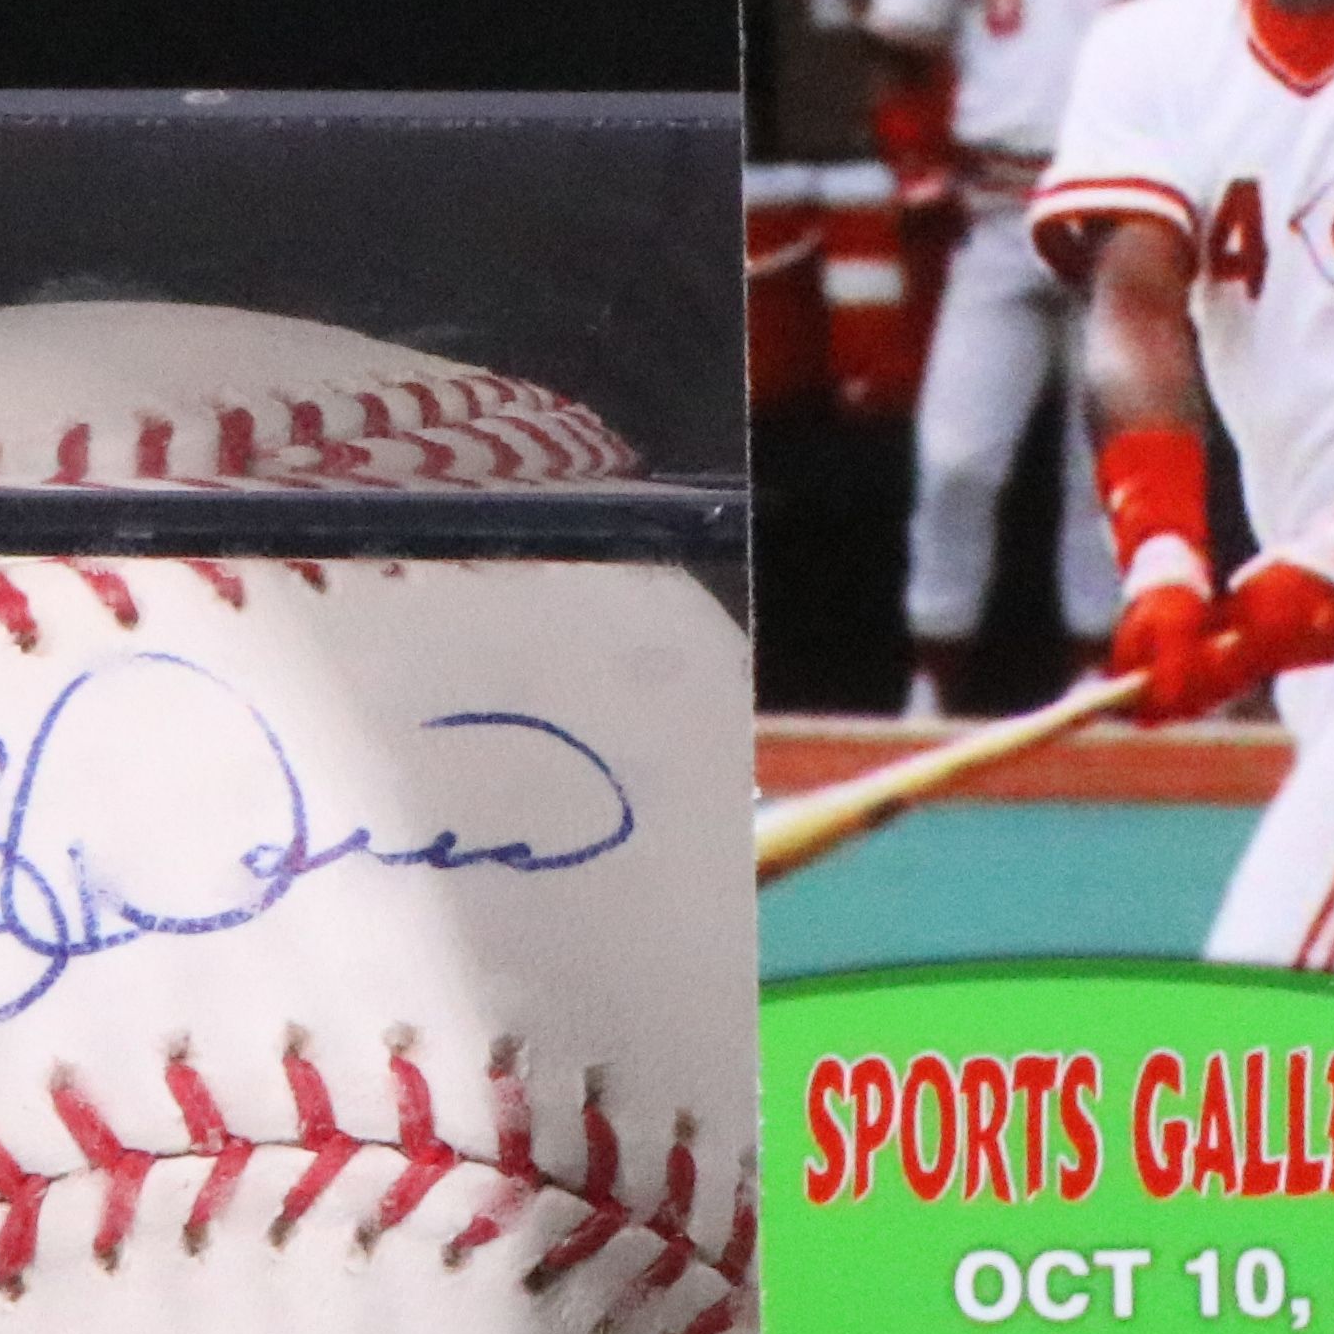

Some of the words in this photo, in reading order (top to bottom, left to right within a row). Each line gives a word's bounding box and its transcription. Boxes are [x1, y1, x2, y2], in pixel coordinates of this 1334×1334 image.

[1207, 176, 1269, 301] 4
[802, 1050, 1104, 1207] SPORTS
[954, 1250, 1150, 1322] OCT
[1186, 1249, 1310, 1328] 10,
